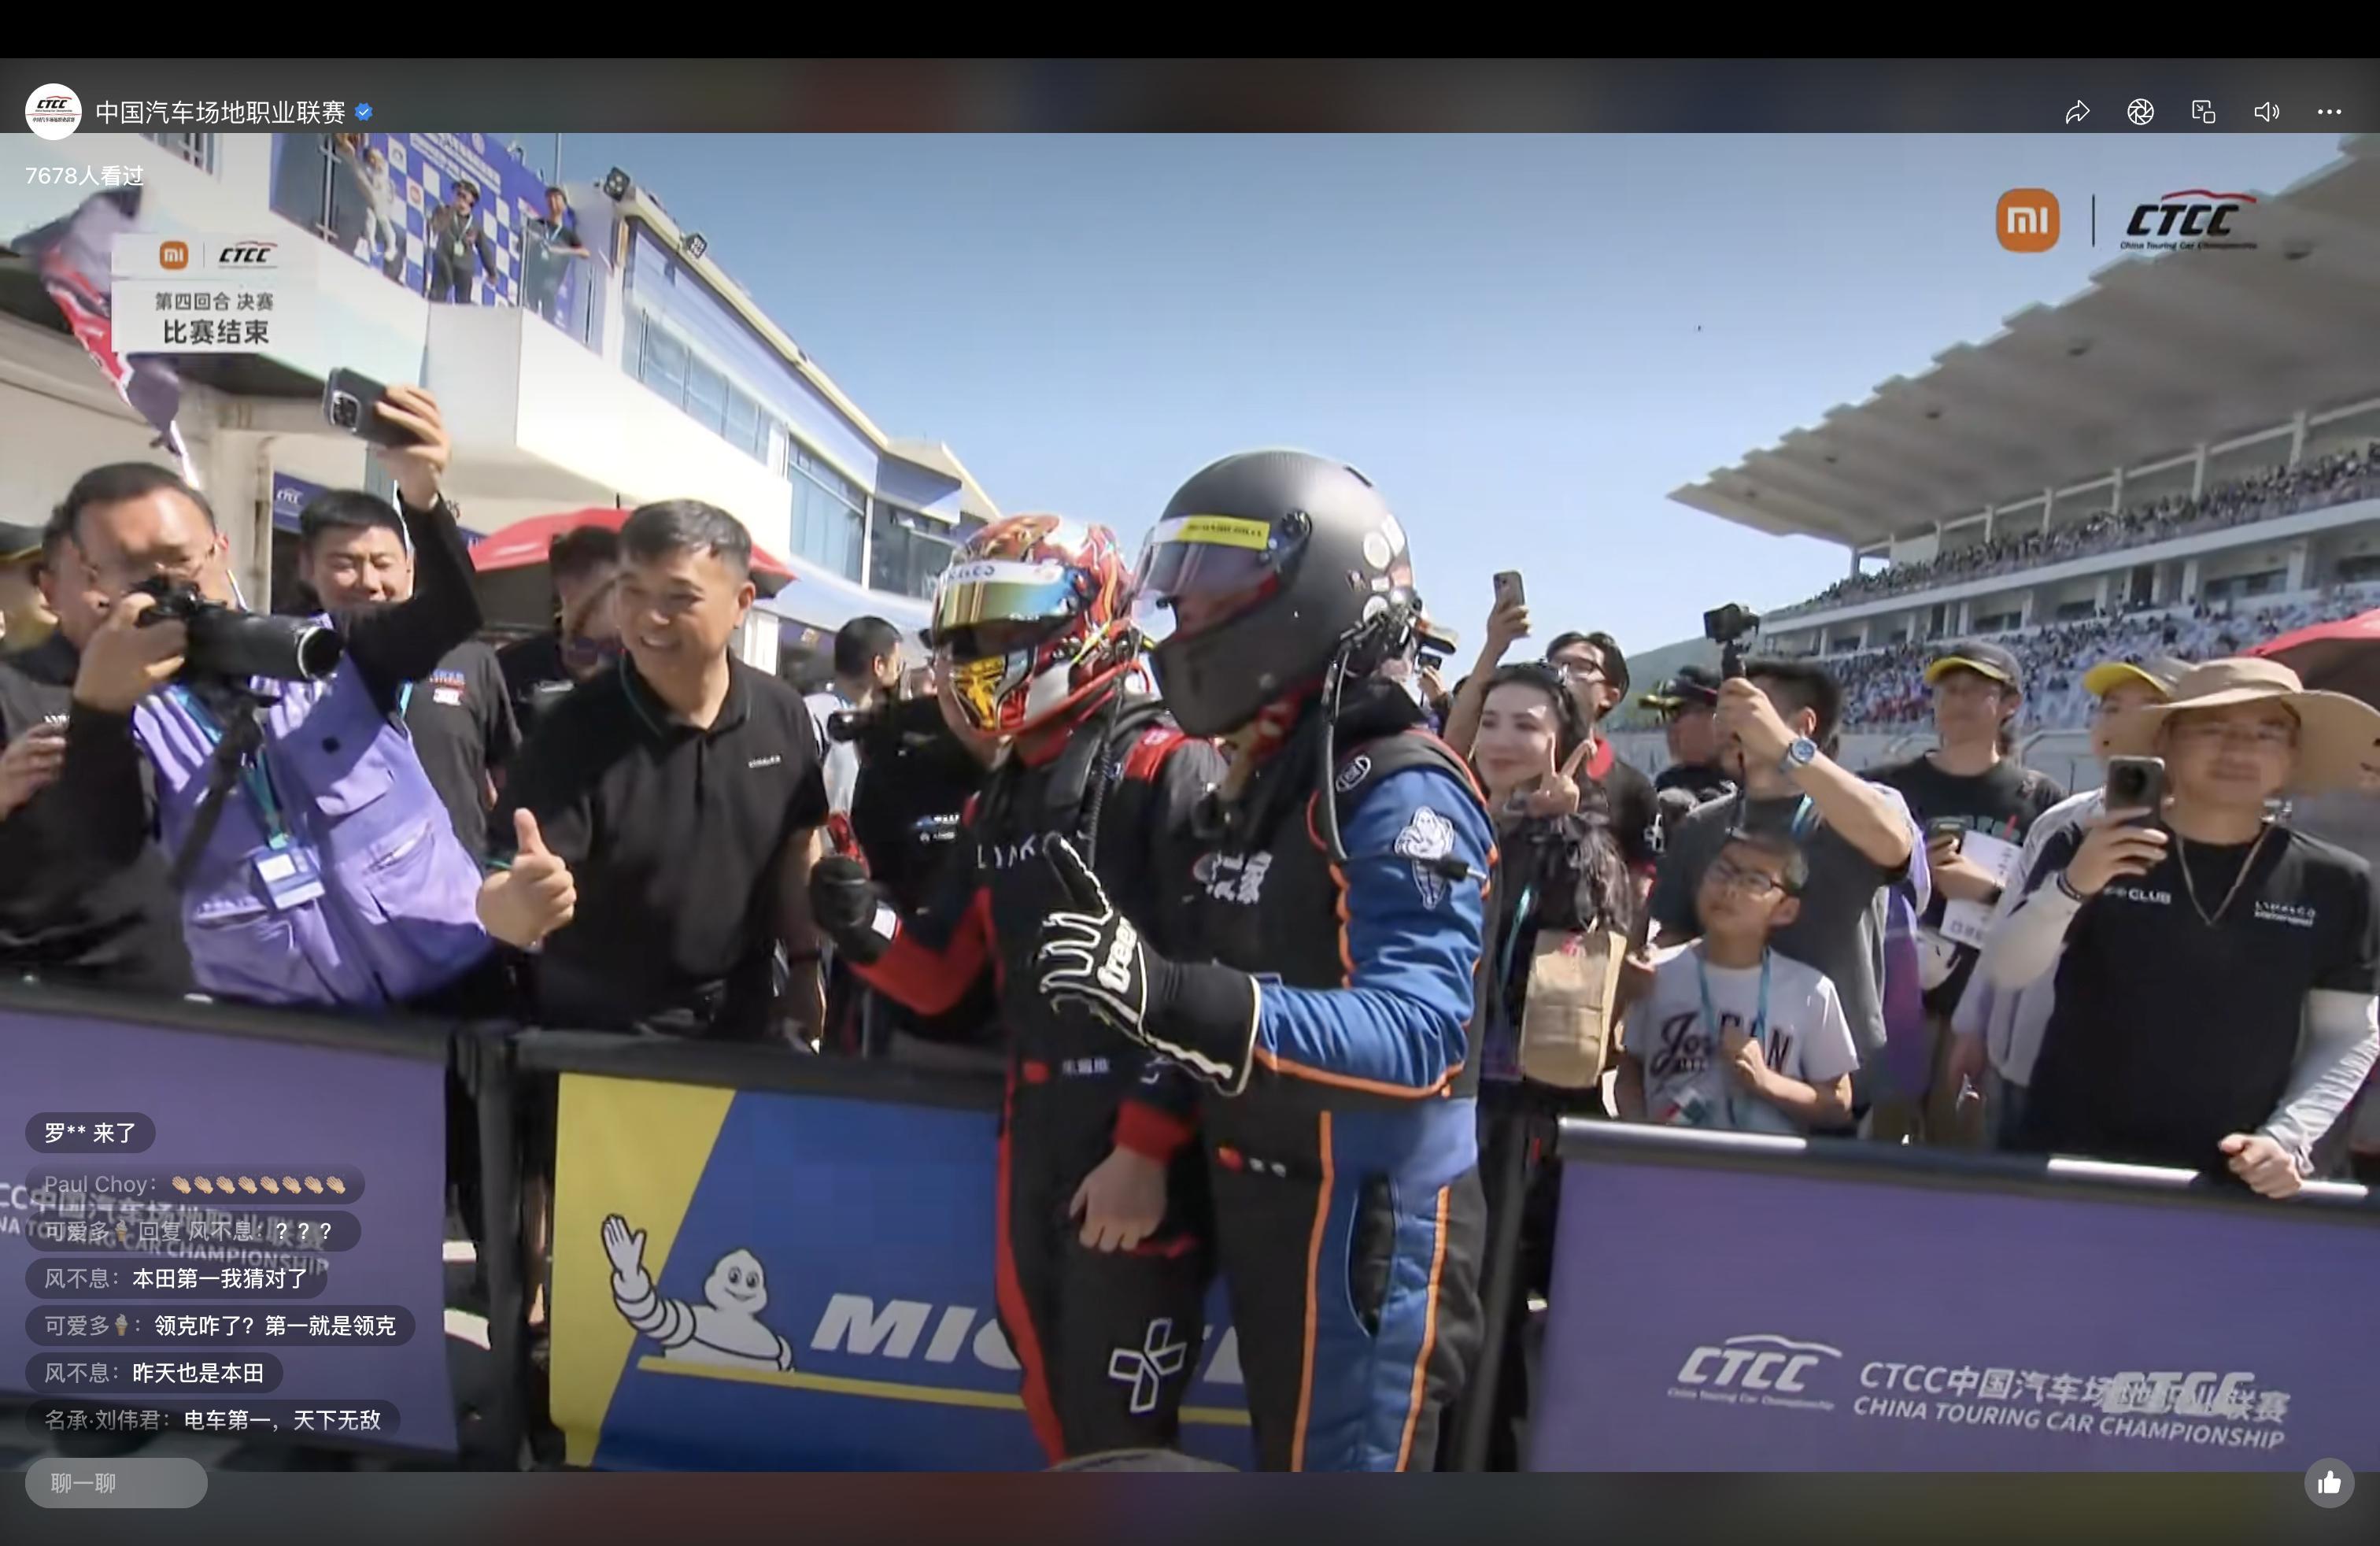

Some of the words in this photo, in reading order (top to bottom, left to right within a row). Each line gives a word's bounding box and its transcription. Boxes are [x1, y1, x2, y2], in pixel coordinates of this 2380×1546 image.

[1677, 1346, 1820, 1392] CTCC
[1853, 1396, 1927, 1420] CHINA
[1934, 1402, 2041, 1429] TOURING
[2046, 1412, 2094, 1435] CAR
[2099, 1416, 2286, 1449] CHAMPIONSHIP
